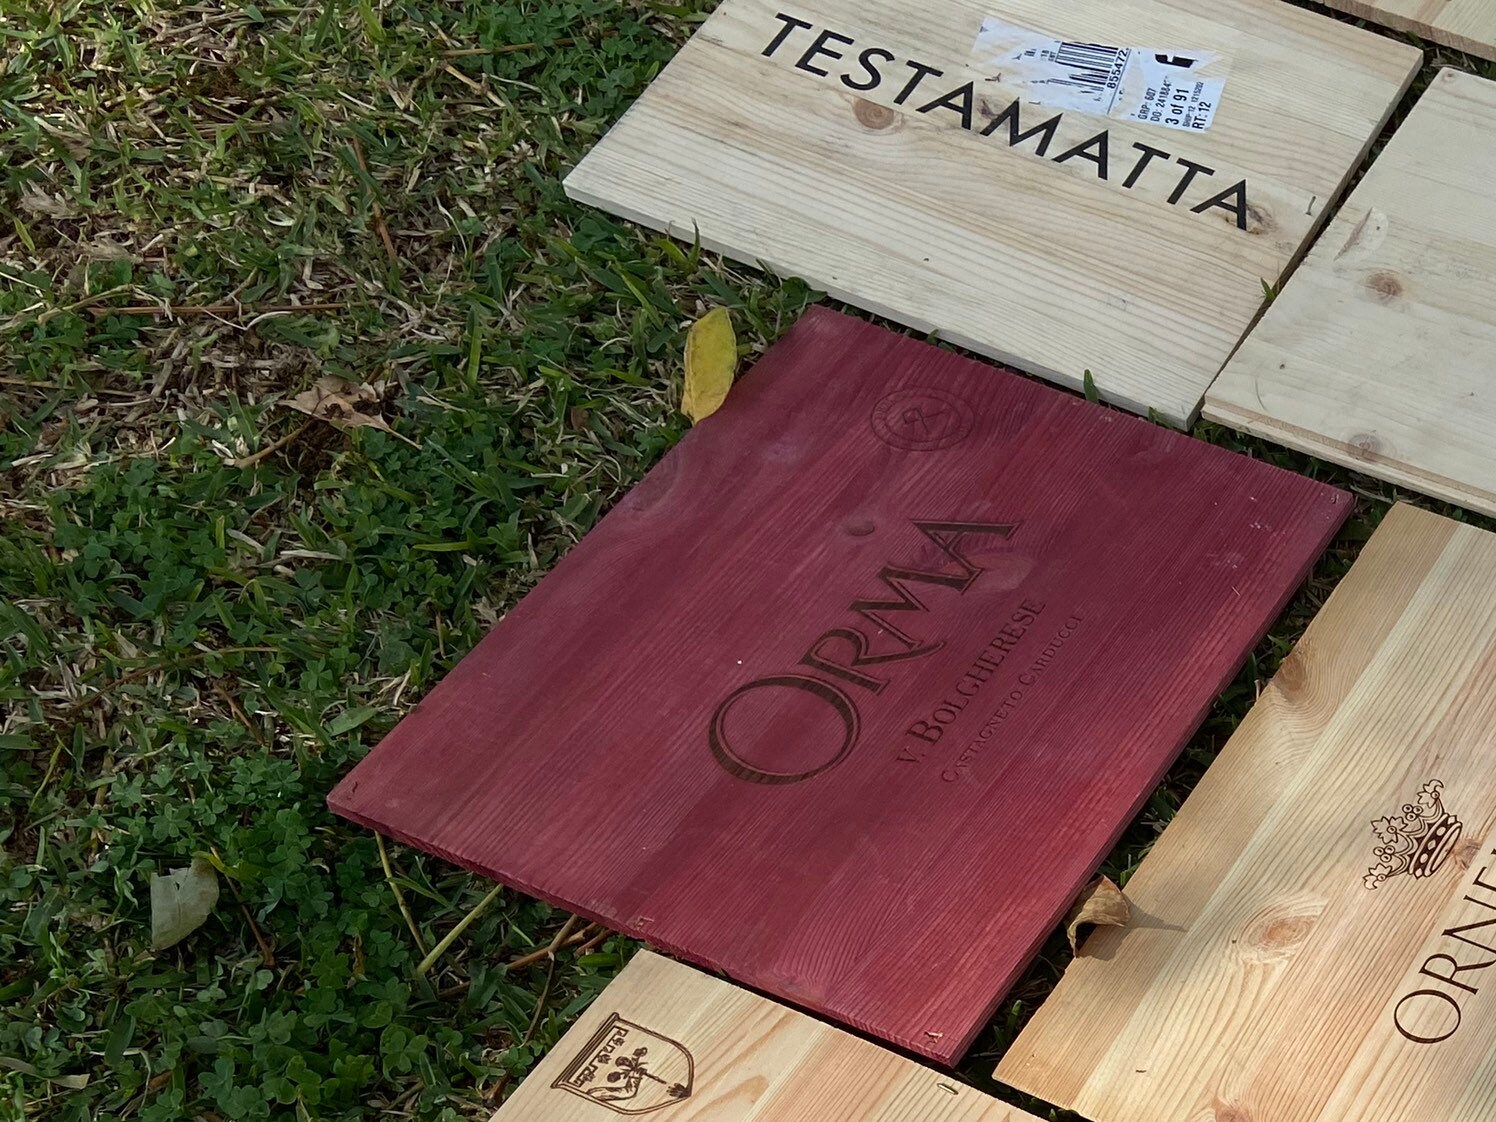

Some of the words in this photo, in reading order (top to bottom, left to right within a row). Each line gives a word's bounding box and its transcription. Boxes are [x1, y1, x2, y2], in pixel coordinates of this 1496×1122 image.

[1106, 47, 1130, 89] 855472
[1170, 103, 1185, 115] of
[1173, 88, 1190, 102] 91
[1198, 101, 1212, 112] 12
[760, 13, 1248, 232] TESTAMATTA
[1165, 117, 1179, 125] 3
[1191, 114, 1208, 130] RT:
[708, 518, 1022, 786] ORMA
[905, 599, 1046, 745] BOLGHERESE
[941, 690, 1023, 783] CASTAGNETO
[1018, 615, 1084, 687] CARDUCCI
